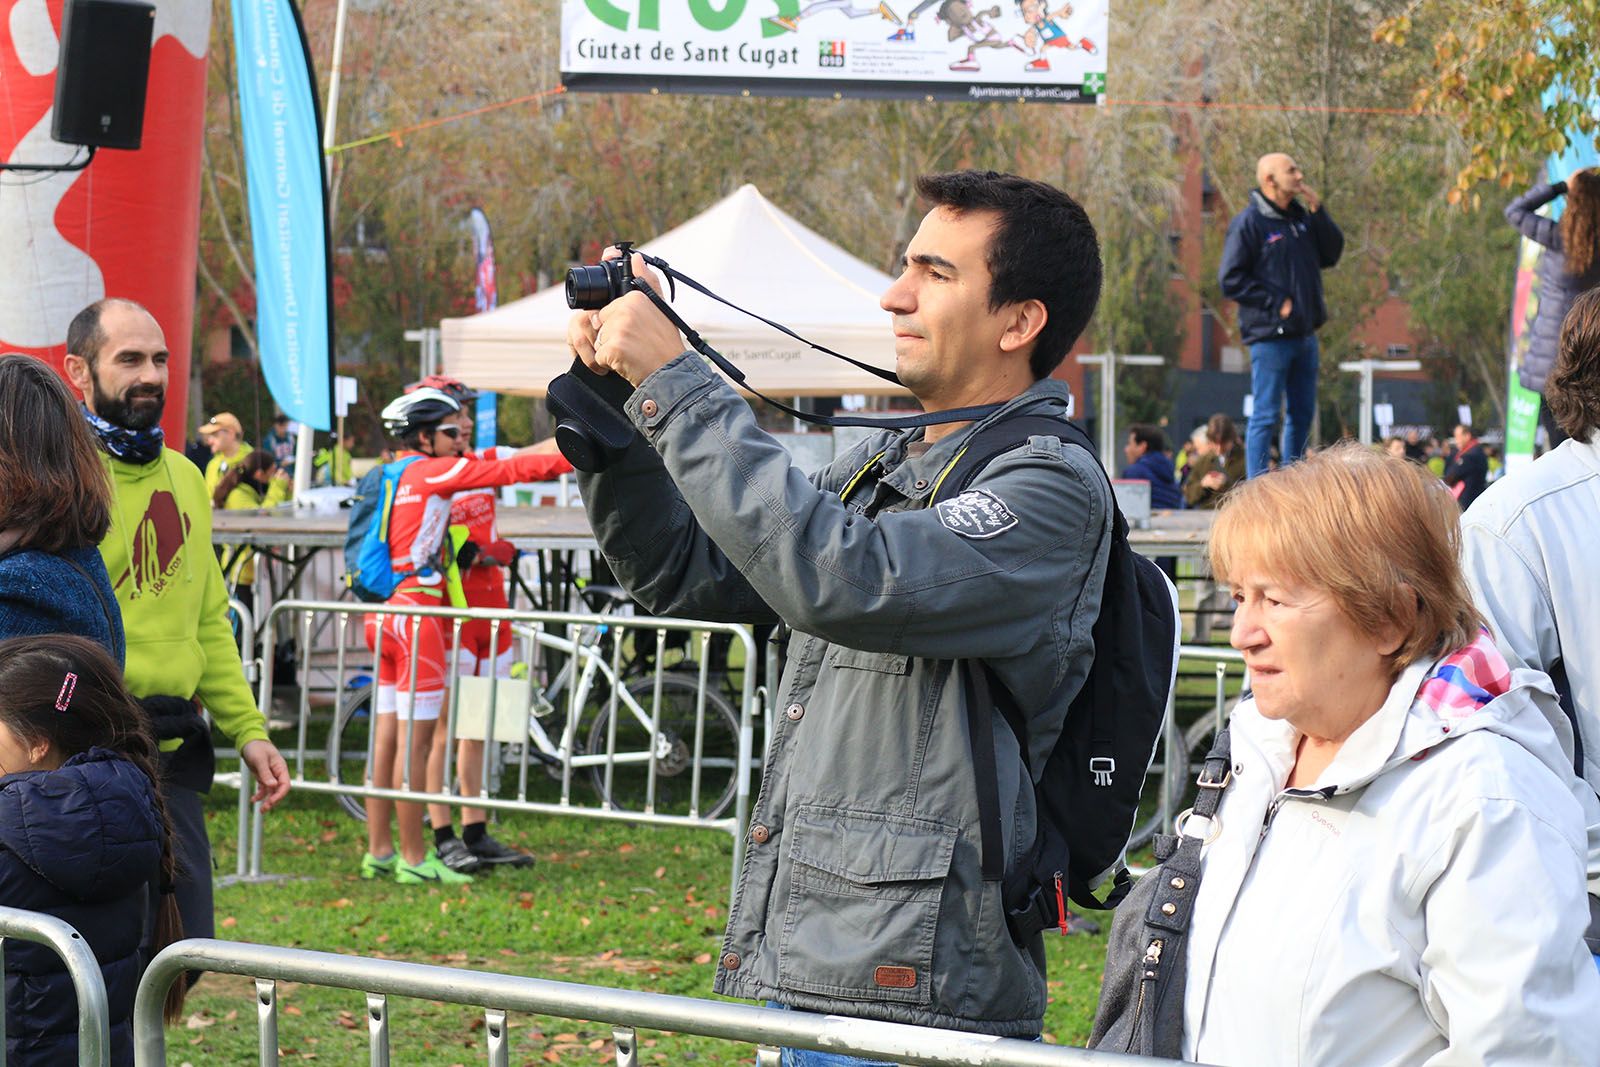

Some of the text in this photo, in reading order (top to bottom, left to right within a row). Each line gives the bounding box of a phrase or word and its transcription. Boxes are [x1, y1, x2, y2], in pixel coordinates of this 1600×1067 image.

[578, 38, 798, 68] Ciutat de Sant Cugat
[969, 85, 1080, 100] Ajuntament de SantCugat
[728, 350, 802, 362] de SantCugat
